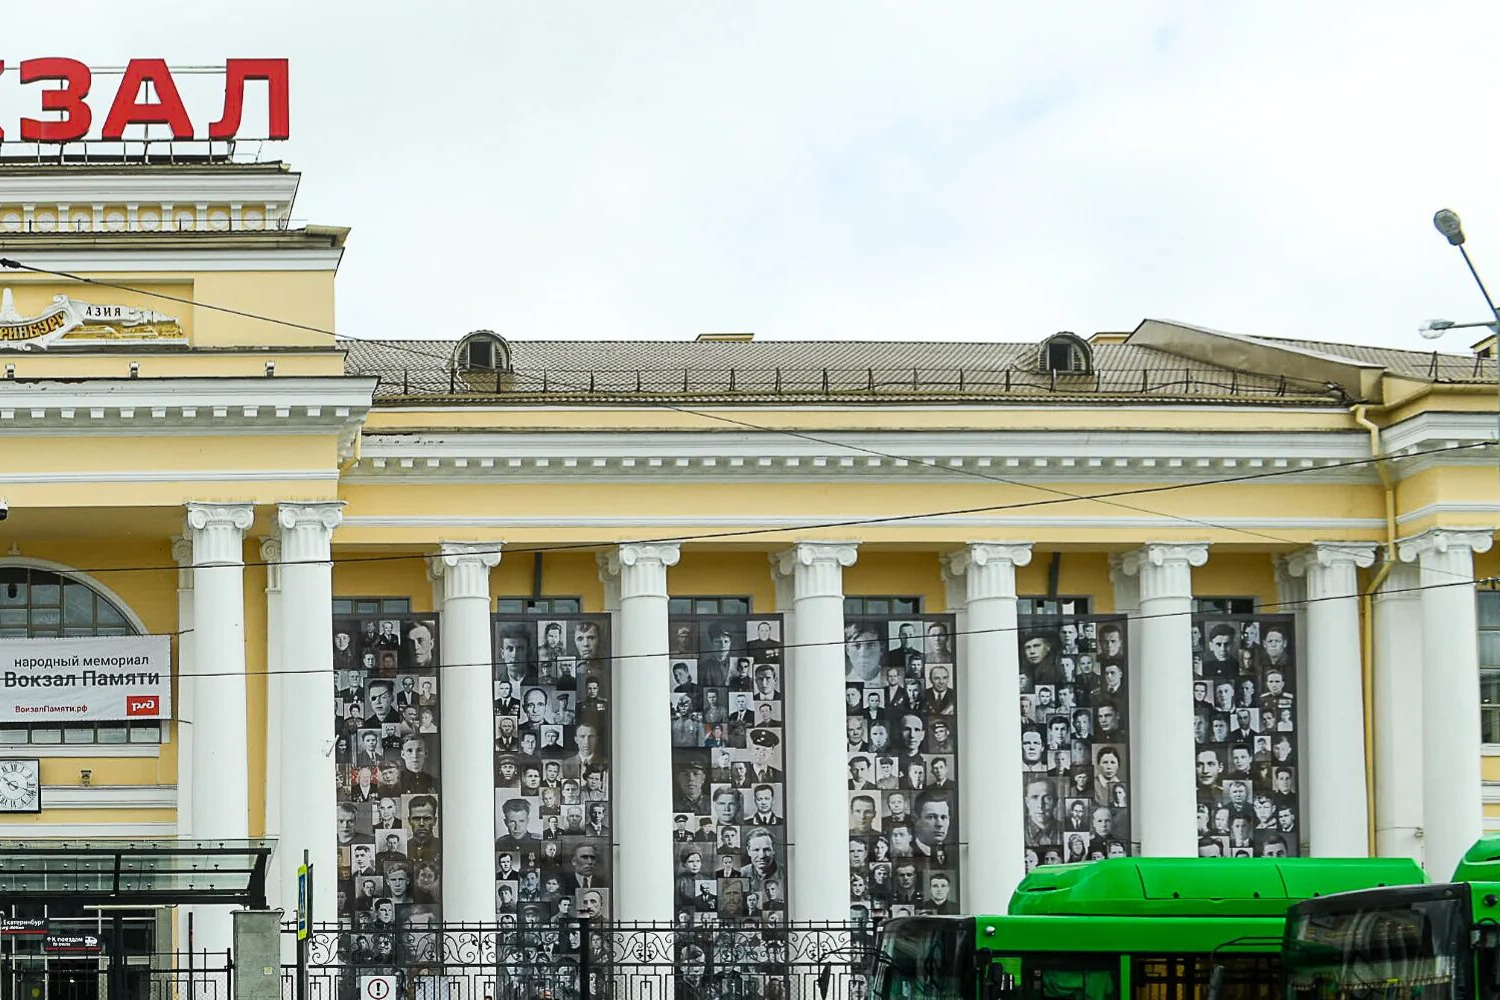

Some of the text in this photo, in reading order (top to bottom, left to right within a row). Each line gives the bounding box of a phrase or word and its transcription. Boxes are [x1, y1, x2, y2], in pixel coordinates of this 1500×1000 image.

[85, 306, 122, 318] АЗИЯ
[14, 656, 149, 669] народный мемориал
[4, 670, 160, 688] Вокзал Памяти
[15, 705, 88, 714] ВокзалПамяти.рф
